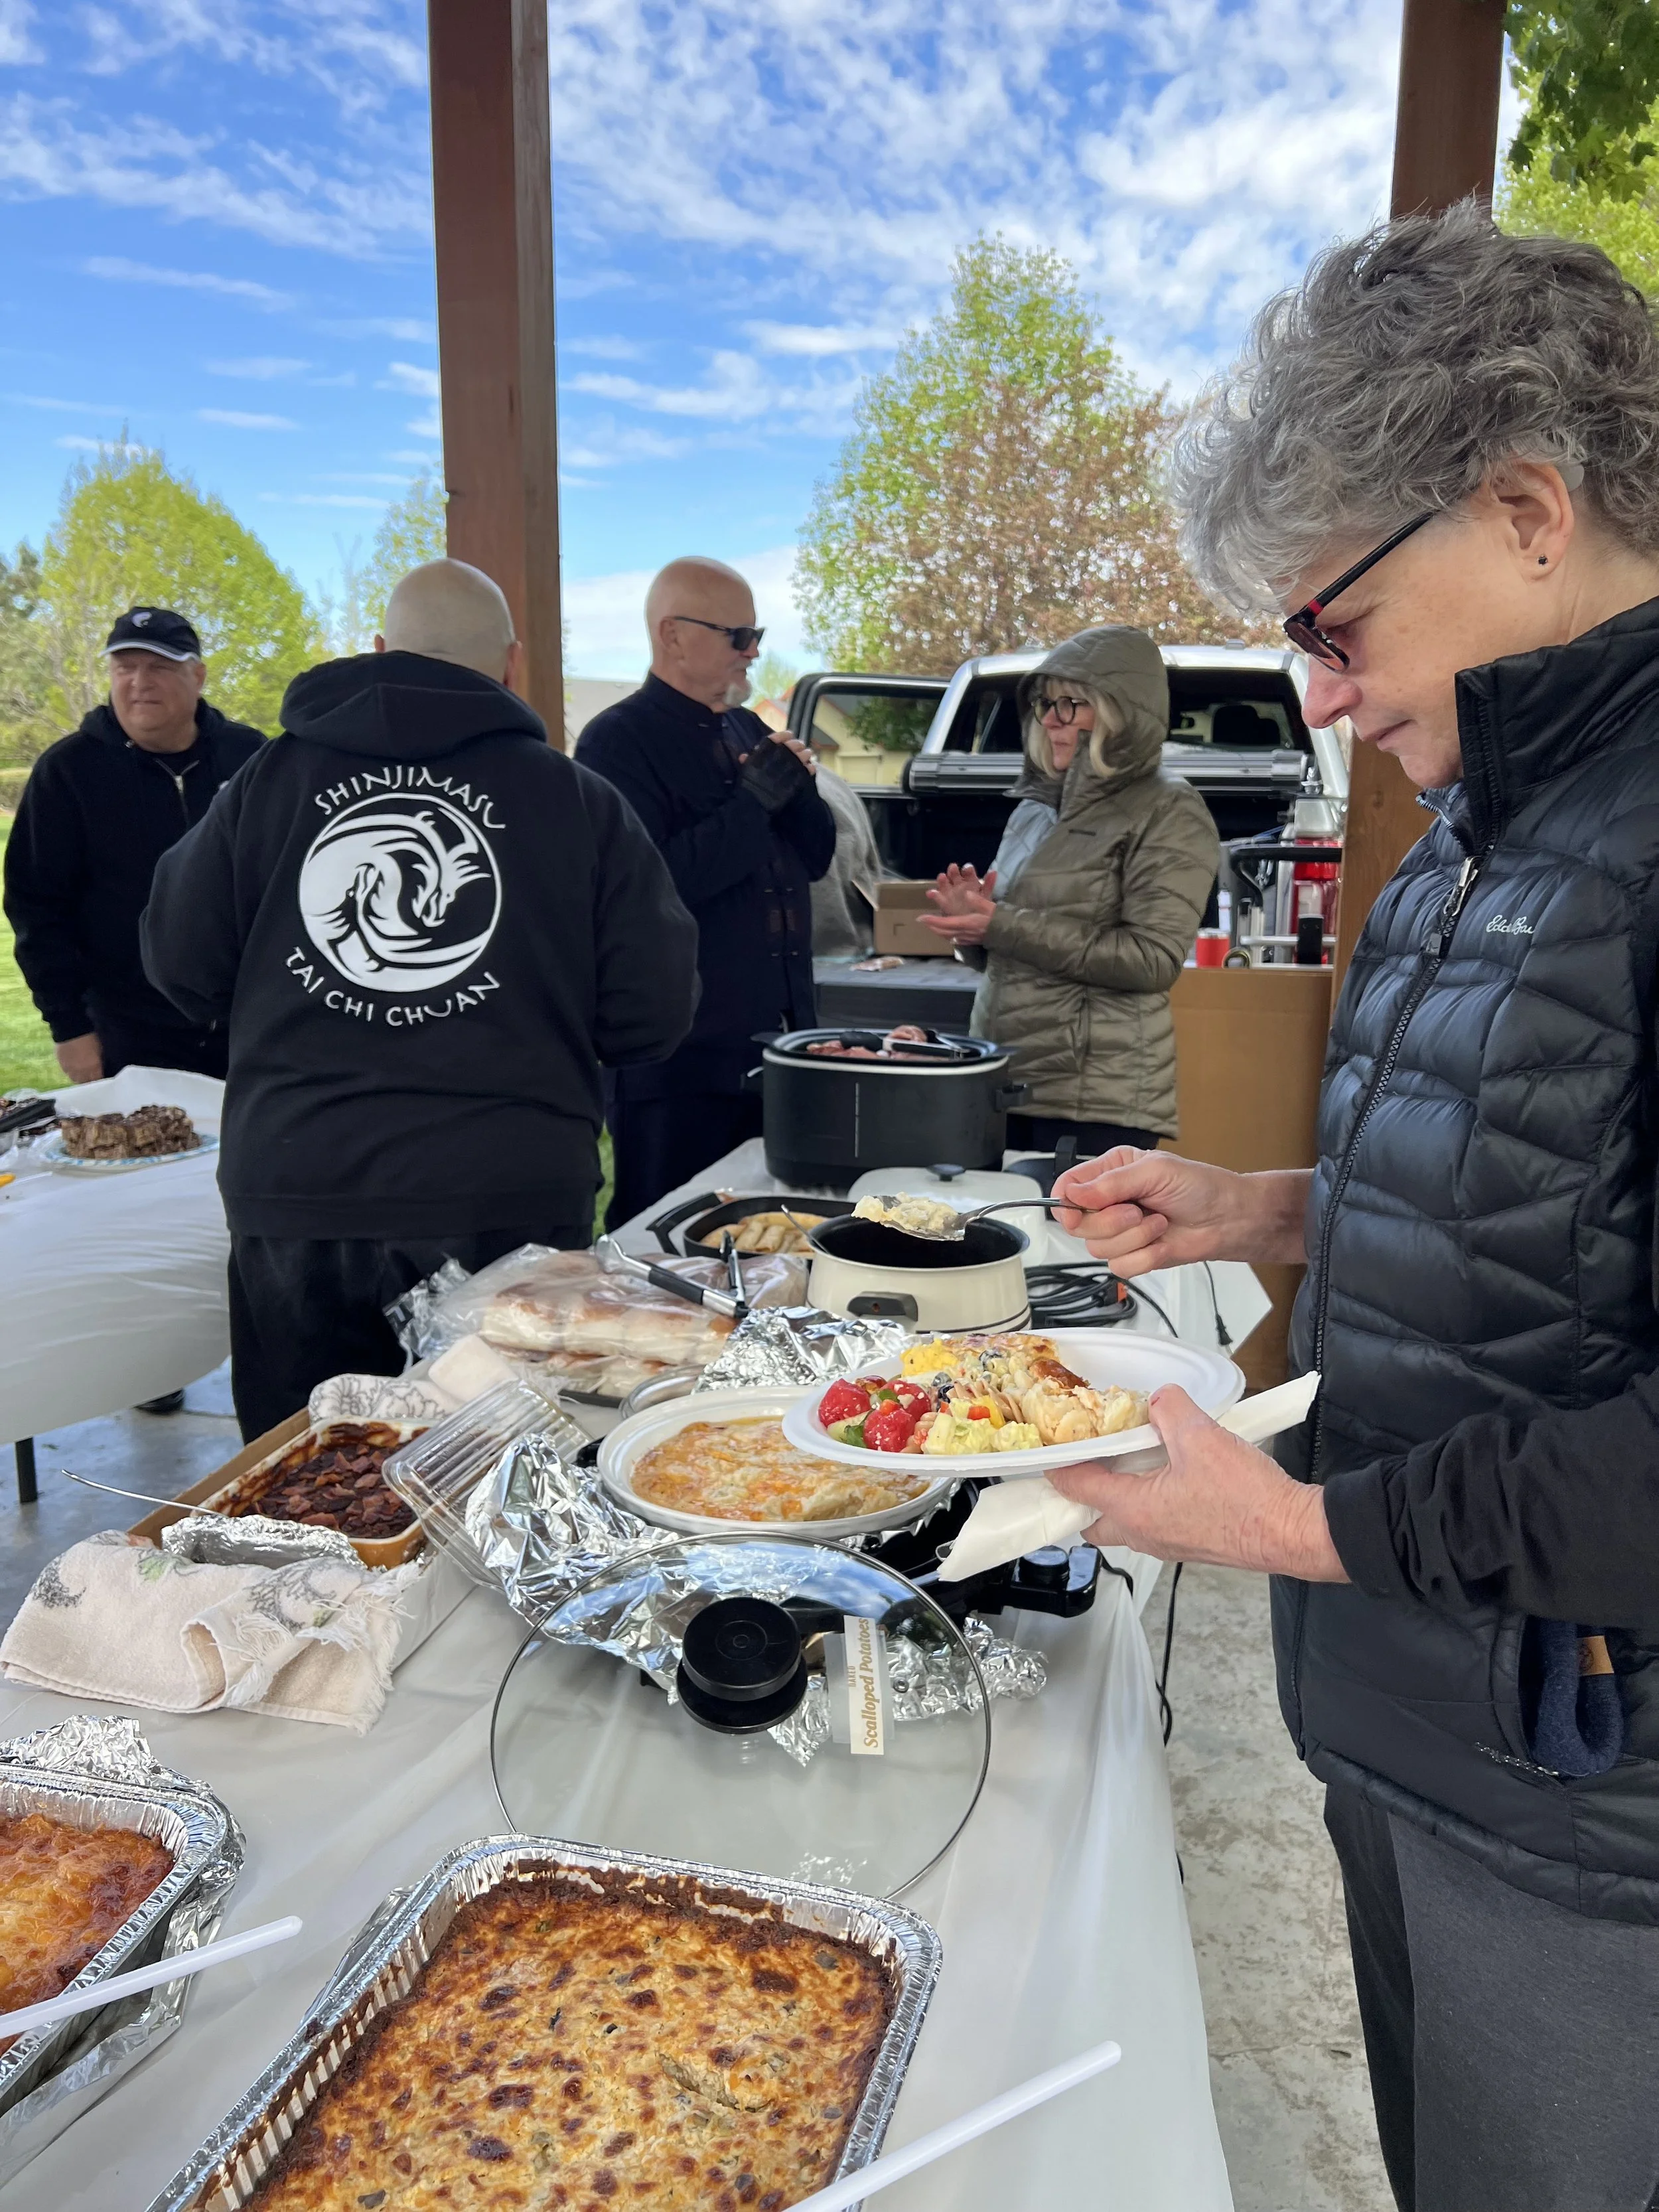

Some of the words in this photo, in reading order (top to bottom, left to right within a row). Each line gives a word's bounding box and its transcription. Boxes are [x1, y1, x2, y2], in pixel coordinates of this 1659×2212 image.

[315, 765, 506, 829] SHINJIMASU
[286, 946, 325, 994] TAI
[325, 990, 374, 1022] CHI
[386, 972, 500, 1027] CHUAN
[858, 1618, 873, 1674] Potatoes
[859, 1674, 880, 1748] Scalloped
